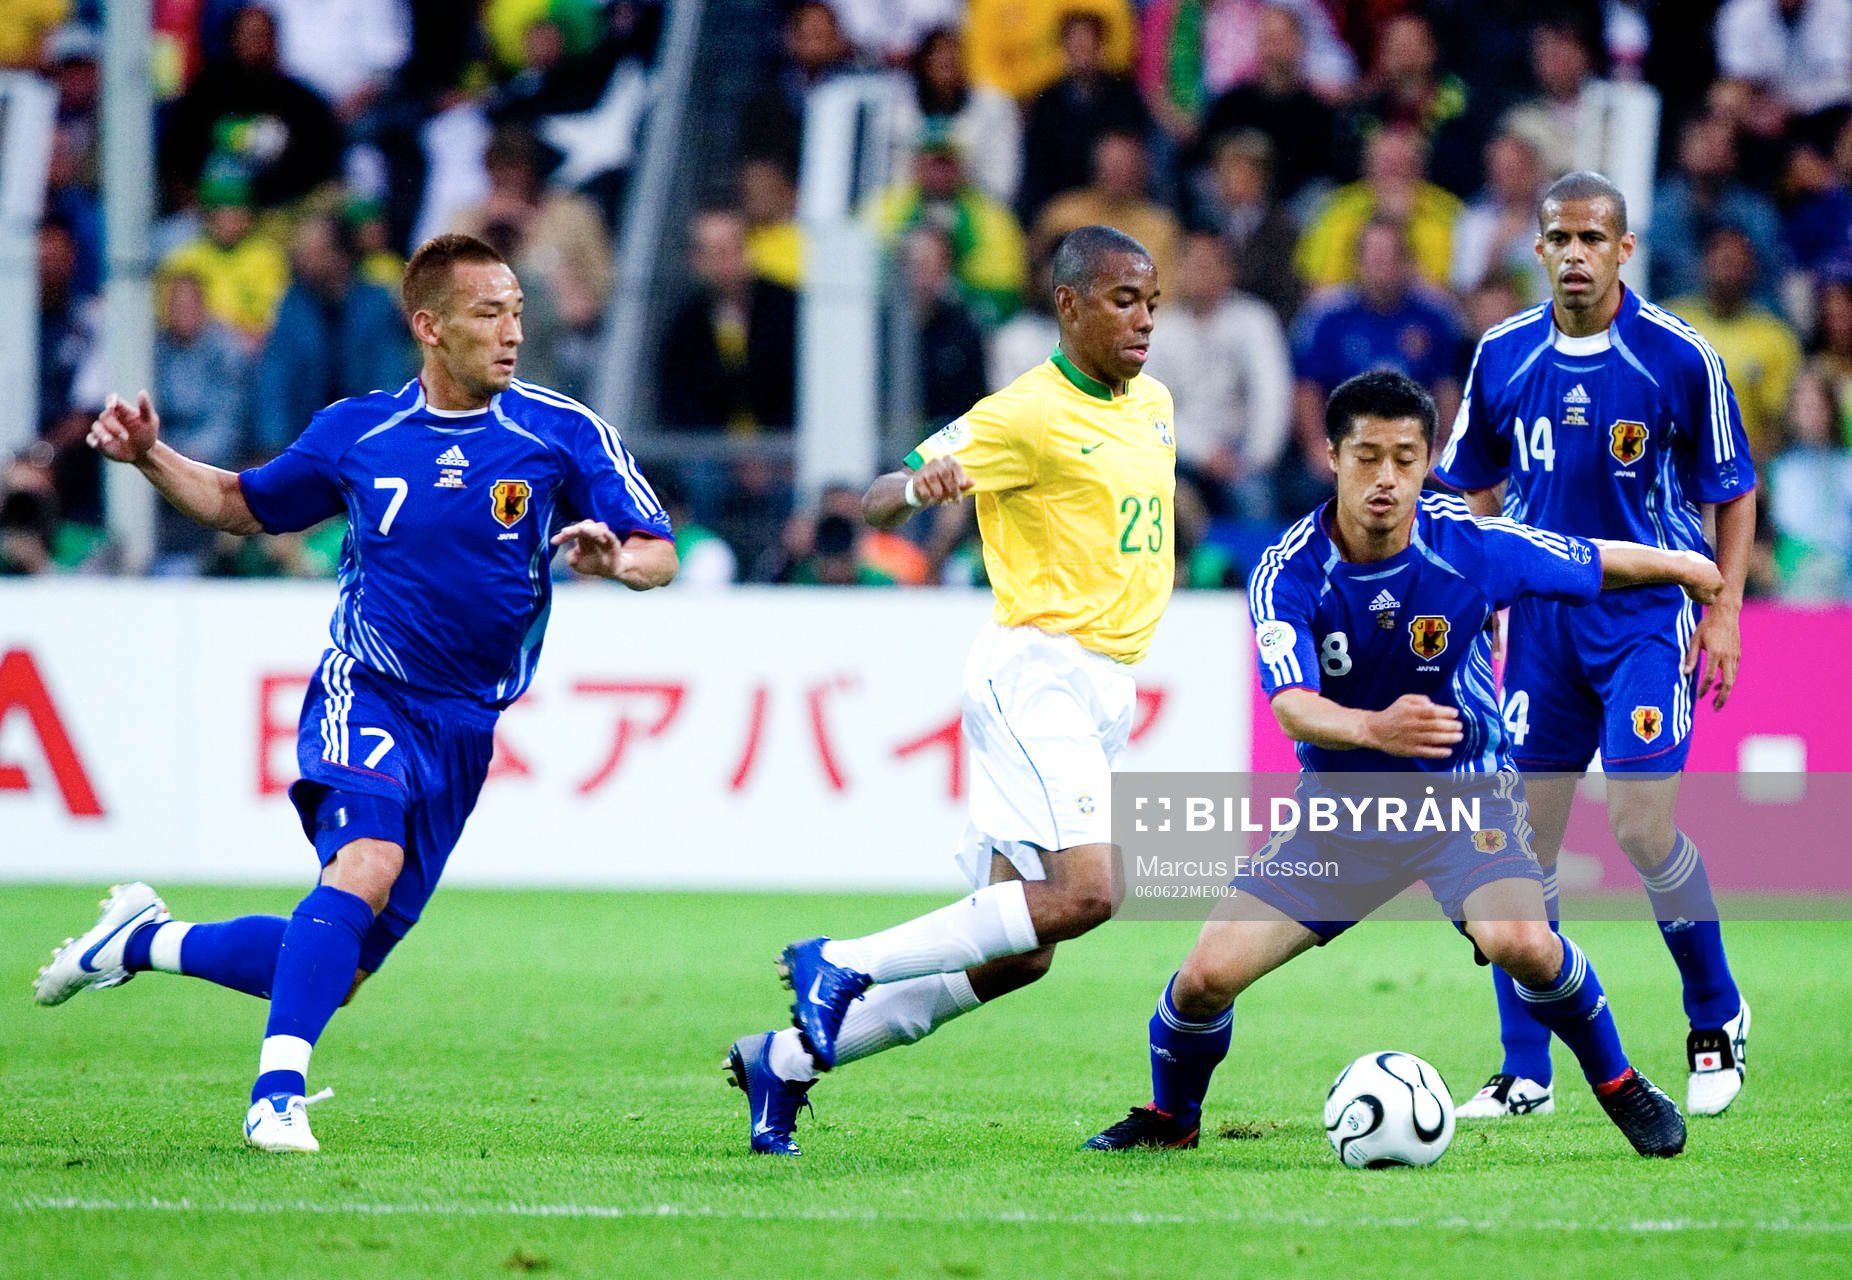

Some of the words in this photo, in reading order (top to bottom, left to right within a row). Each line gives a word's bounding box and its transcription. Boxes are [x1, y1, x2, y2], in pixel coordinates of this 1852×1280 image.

[435, 457, 470, 467] adidas
[1514, 416, 1556, 471] 14
[373, 477, 409, 537] 7
[1120, 496, 1163, 553] 23
[1368, 601, 1401, 611] adidas
[1320, 631, 1353, 677] 8
[359, 726, 396, 770] 7
